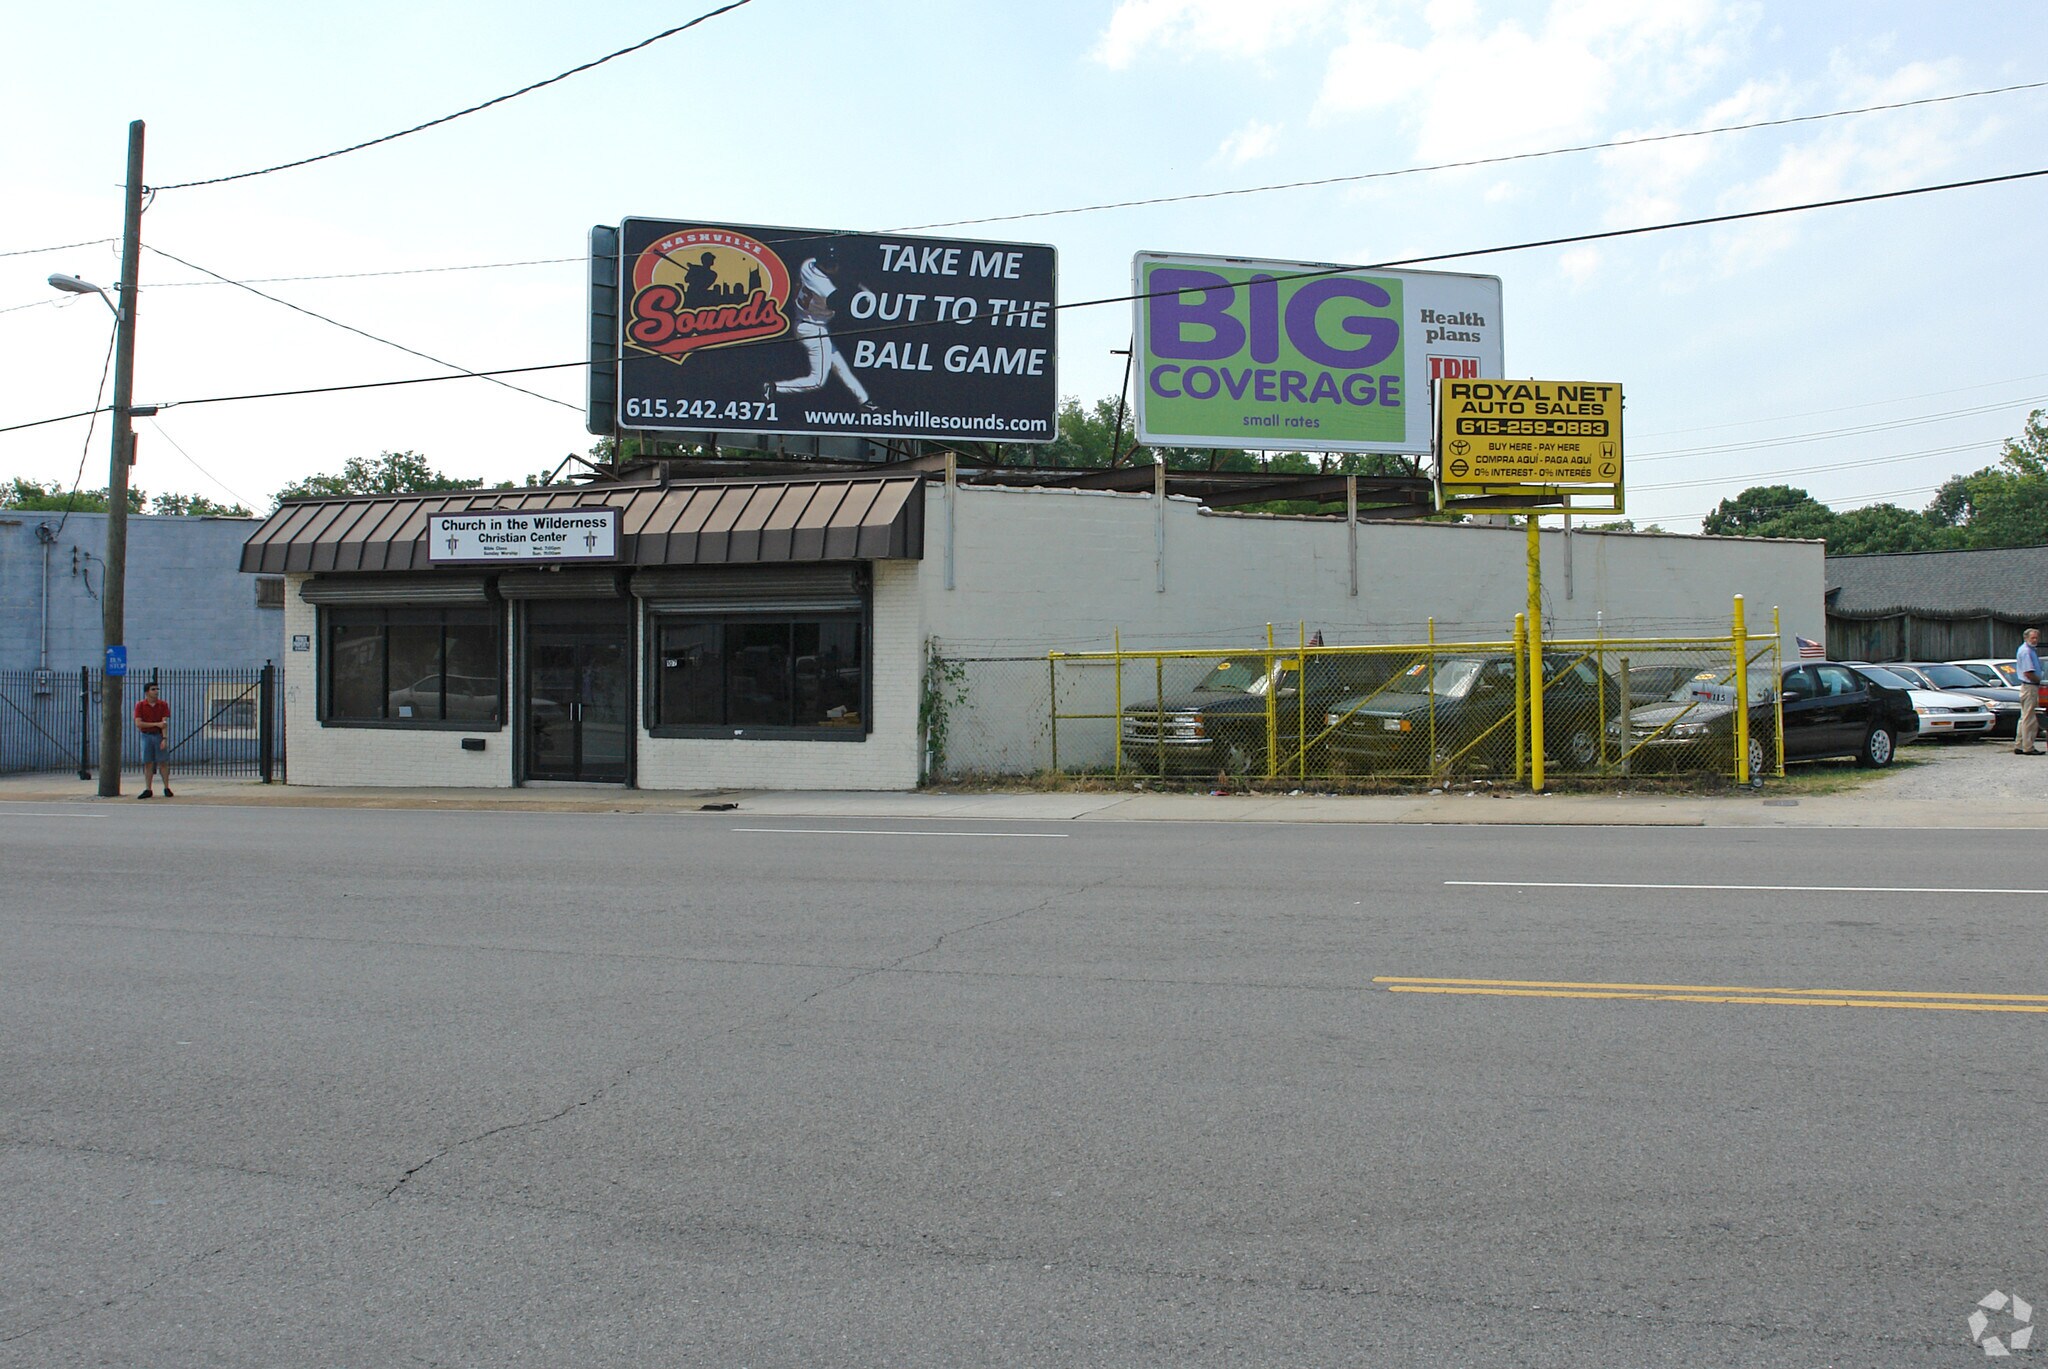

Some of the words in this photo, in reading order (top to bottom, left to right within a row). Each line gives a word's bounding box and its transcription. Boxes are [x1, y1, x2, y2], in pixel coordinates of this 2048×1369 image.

[661, 233, 762, 255] NASHVILLE
[879, 244, 961, 276] TAKE
[969, 250, 1023, 279] ME
[634, 288, 778, 343] Sounds
[850, 291, 926, 321] OUT
[934, 295, 978, 324] TO
[988, 299, 1050, 328] THE
[1420, 309, 1485, 326] Health
[1150, 268, 1400, 369] BIG
[1426, 327, 1481, 344] plans
[853, 340, 933, 371] BALL
[943, 345, 1047, 376] GAME
[1150, 364, 1401, 407] COVERAGE
[1452, 384, 1550, 400] ROYAL
[1558, 386, 1613, 402] NET
[626, 398, 778, 421] 615.242.4371
[1461, 401, 1524, 414] AUTO
[1535, 402, 1604, 415] SALES
[805, 410, 1047, 432] www.nashvillesounds.com
[1243, 414, 1279, 427] small
[1285, 416, 1320, 428] rates
[1461, 420, 1605, 435] 615-259-0883
[1489, 443, 1507, 451] BUY
[1509, 443, 1532, 451] HERE
[1539, 443, 1555, 451] PAY
[1475, 455, 1514, 464] COMPRA
[1545, 456, 1568, 464] PAGA
[1474, 468, 1489, 477] 0%
[1491, 468, 1533, 476] INTEREST
[1539, 469, 1554, 477] 0%
[442, 519, 486, 531] Church
[491, 519, 502, 530] in
[507, 518, 528, 530] the
[533, 517, 607, 529] Wilderness
[478, 533, 526, 543] Christian
[530, 532, 567, 542] Center
